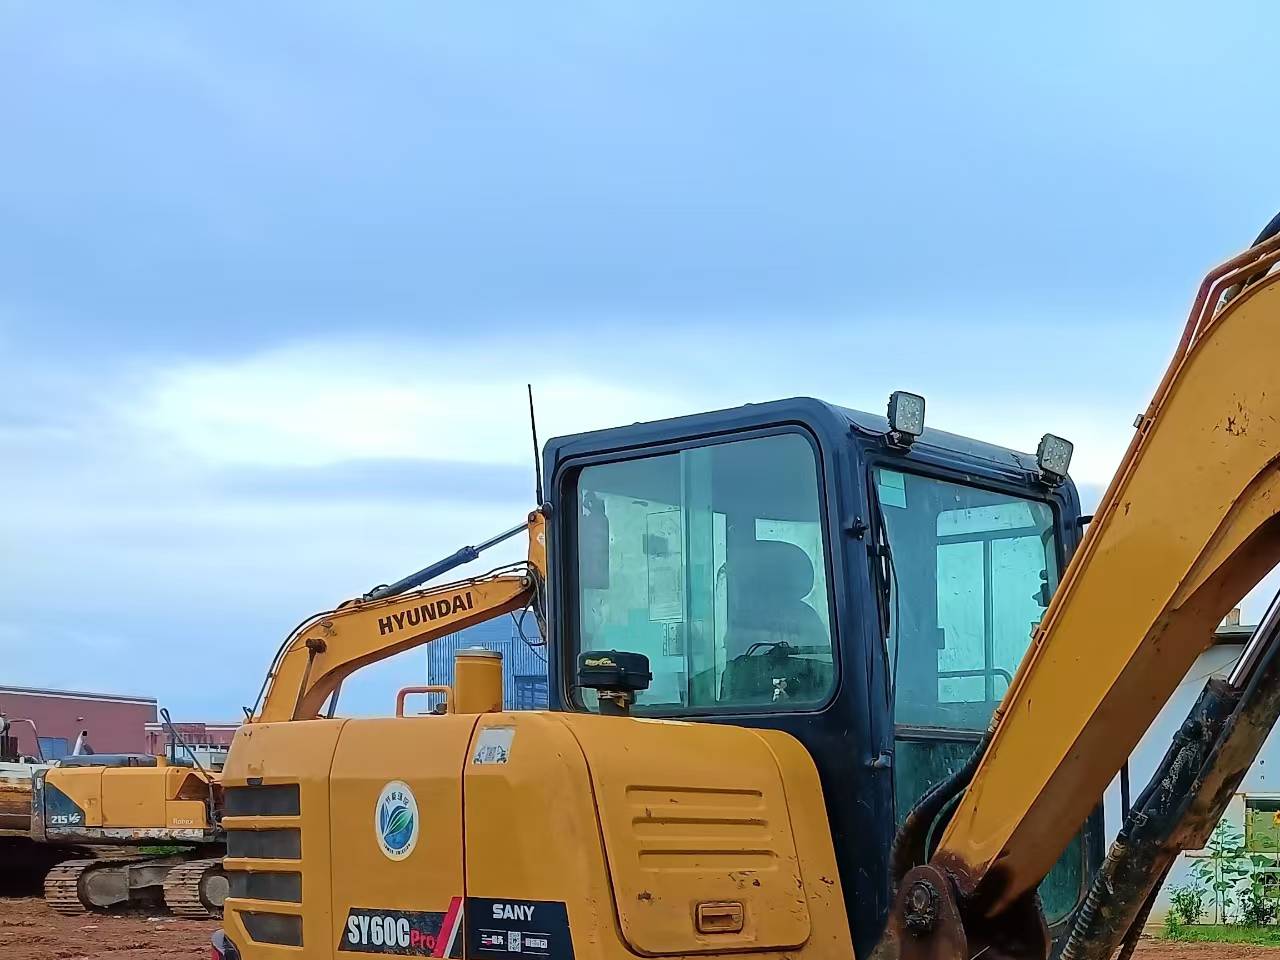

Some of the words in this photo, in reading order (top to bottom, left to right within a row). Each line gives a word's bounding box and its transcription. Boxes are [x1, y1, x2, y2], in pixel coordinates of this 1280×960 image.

[379, 592, 474, 635] HYUNDAI
[492, 903, 535, 921] SANY
[347, 915, 410, 948] SY60C
[410, 928, 436, 950] Pro
